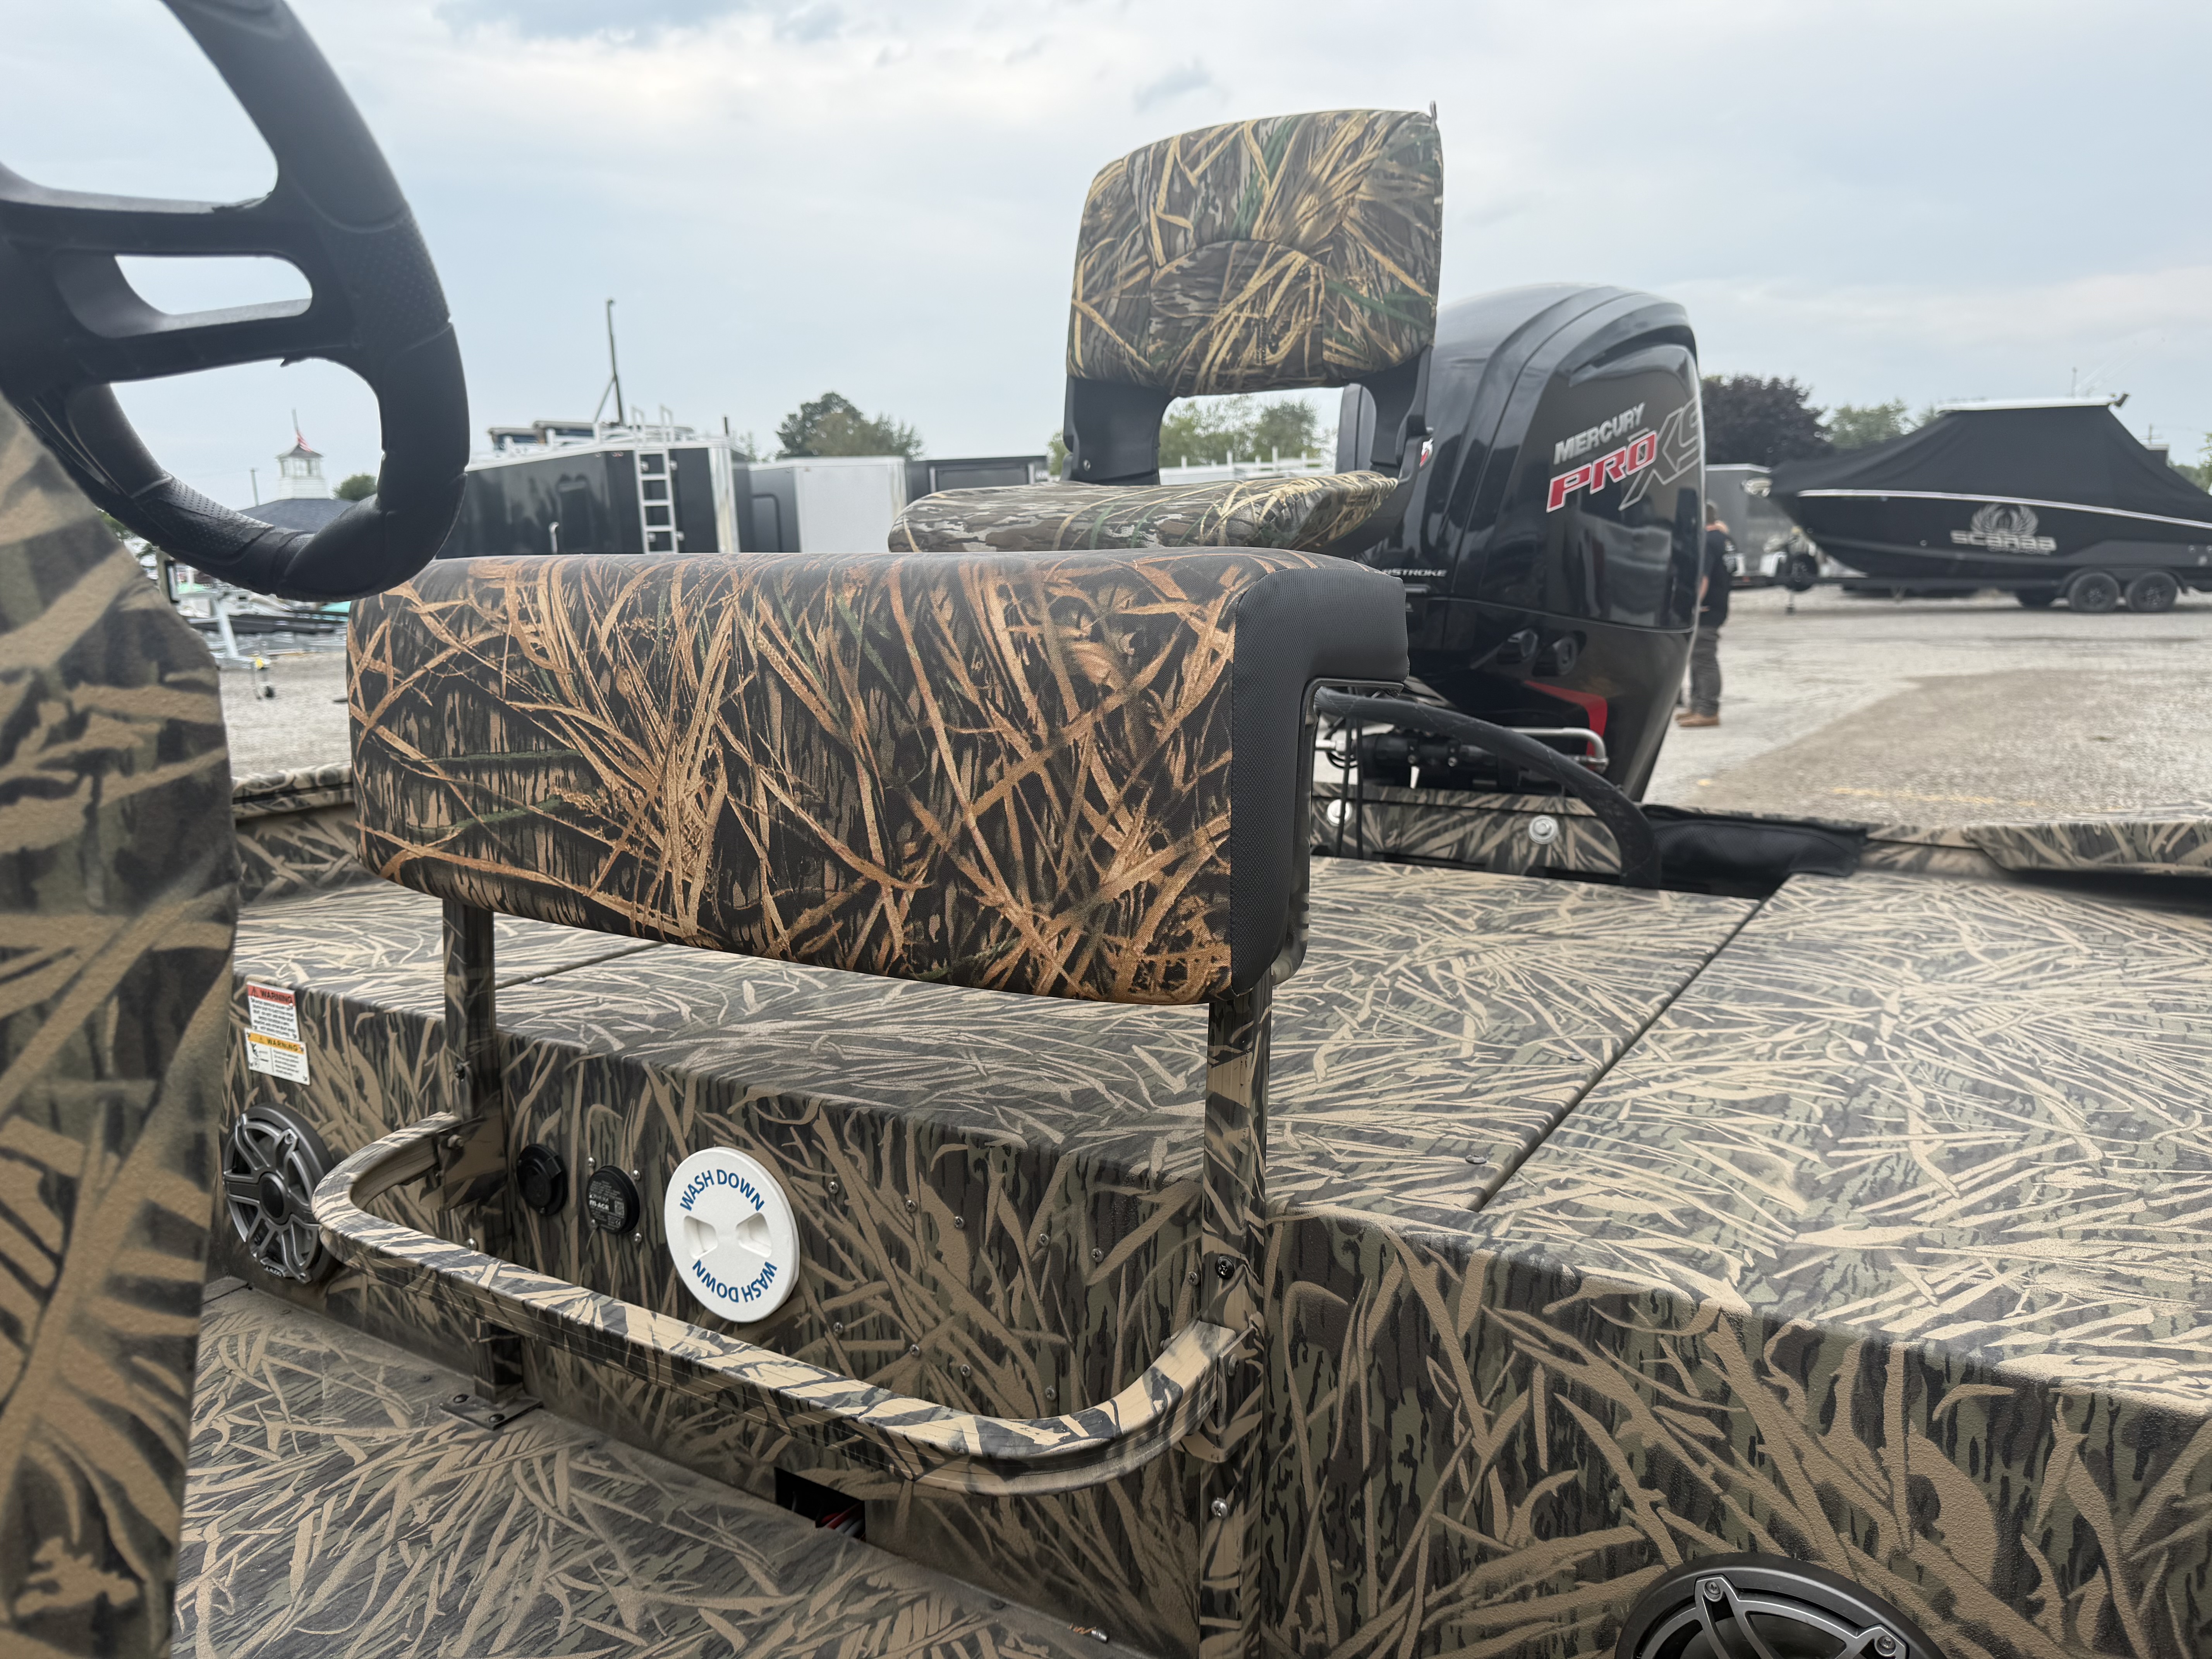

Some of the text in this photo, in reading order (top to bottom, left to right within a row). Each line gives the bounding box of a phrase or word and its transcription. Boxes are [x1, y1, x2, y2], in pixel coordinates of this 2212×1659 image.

[1553, 402, 1646, 465] MERCURY
[1546, 430, 1657, 513] PRO
[260, 991, 293, 1004] WARNING
[267, 1039, 298, 1052] WARNING
[680, 1169, 765, 1211] WASH DOWN
[692, 1260, 777, 1303] WASH DOWN
